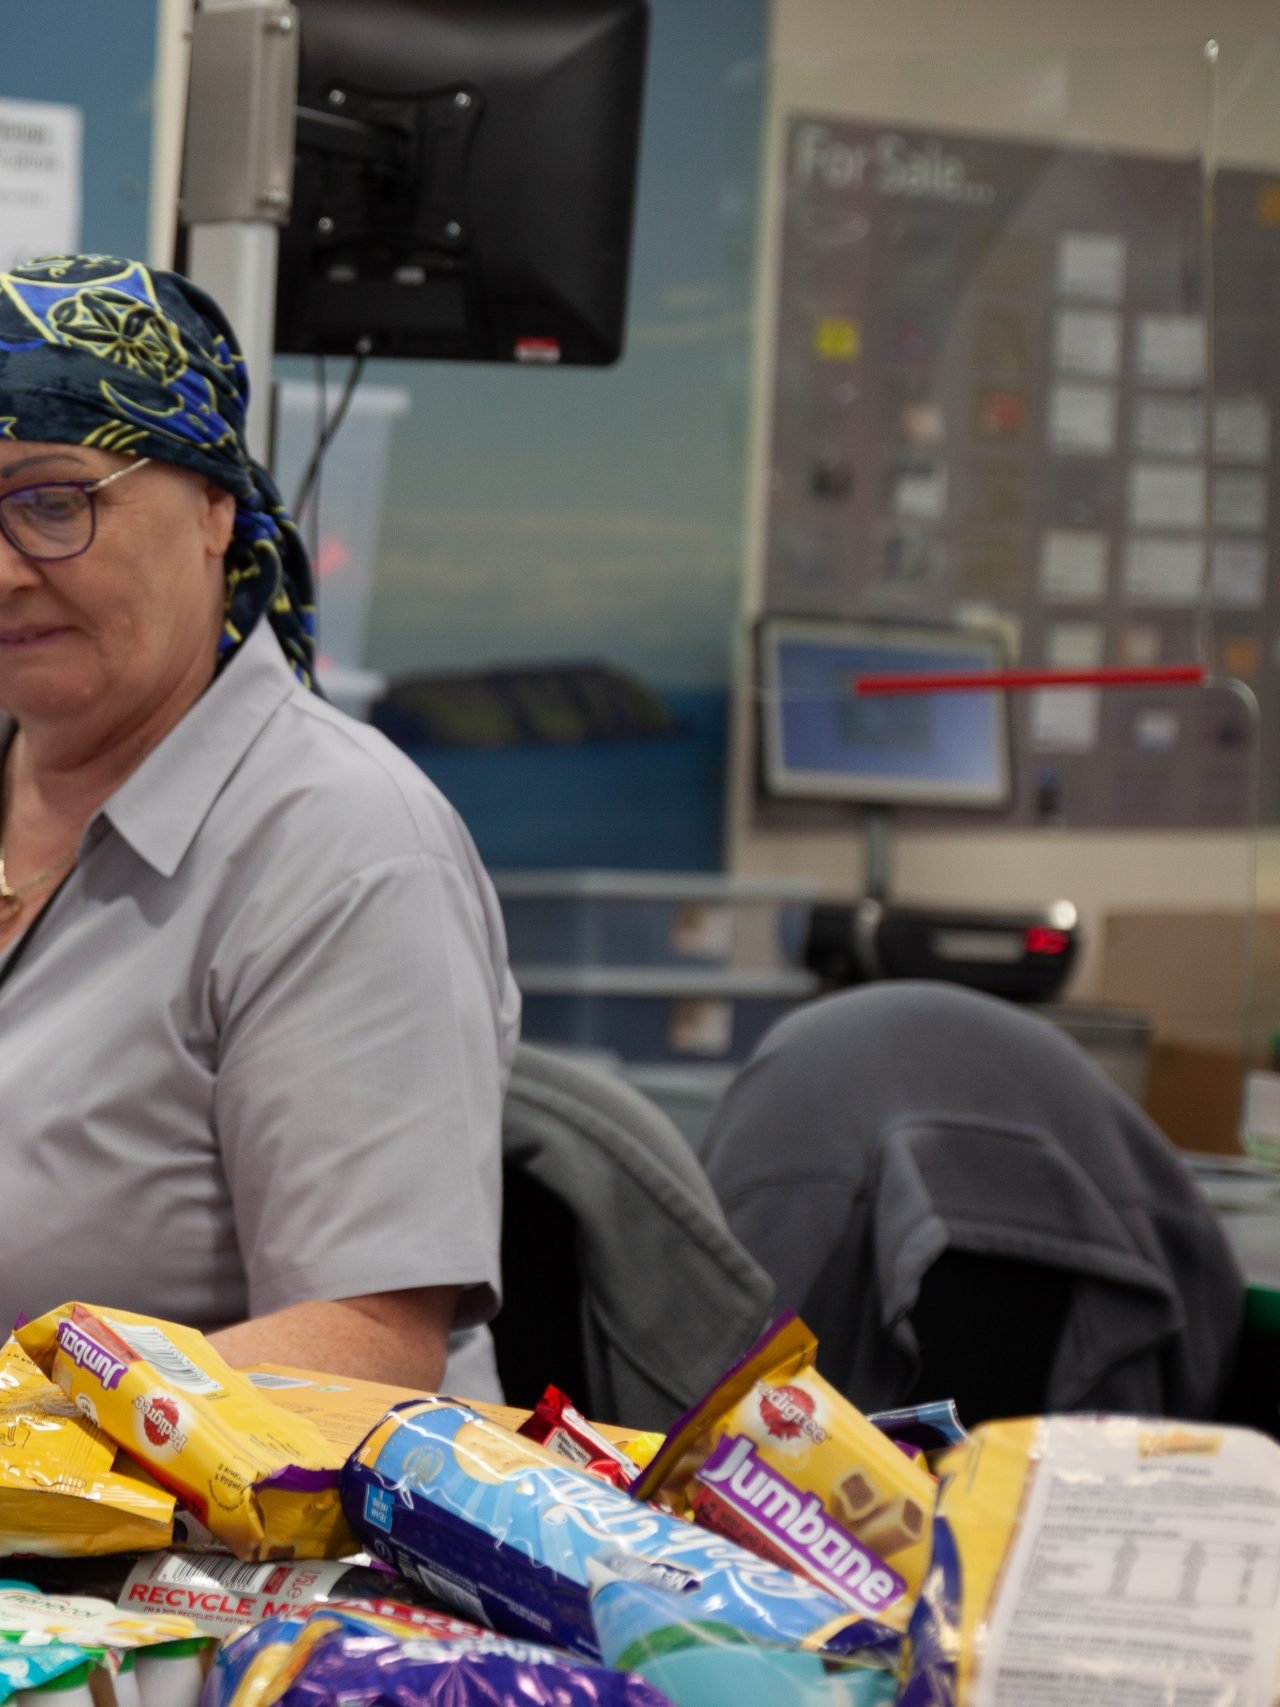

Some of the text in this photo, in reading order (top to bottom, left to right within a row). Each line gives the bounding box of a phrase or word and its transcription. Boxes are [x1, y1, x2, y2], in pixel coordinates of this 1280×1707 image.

[794, 124, 865, 191] For
[132, 1395, 189, 1453] Pedigree
[700, 1437, 896, 1604] Jumbone
[127, 1582, 258, 1617] RECYCLE
